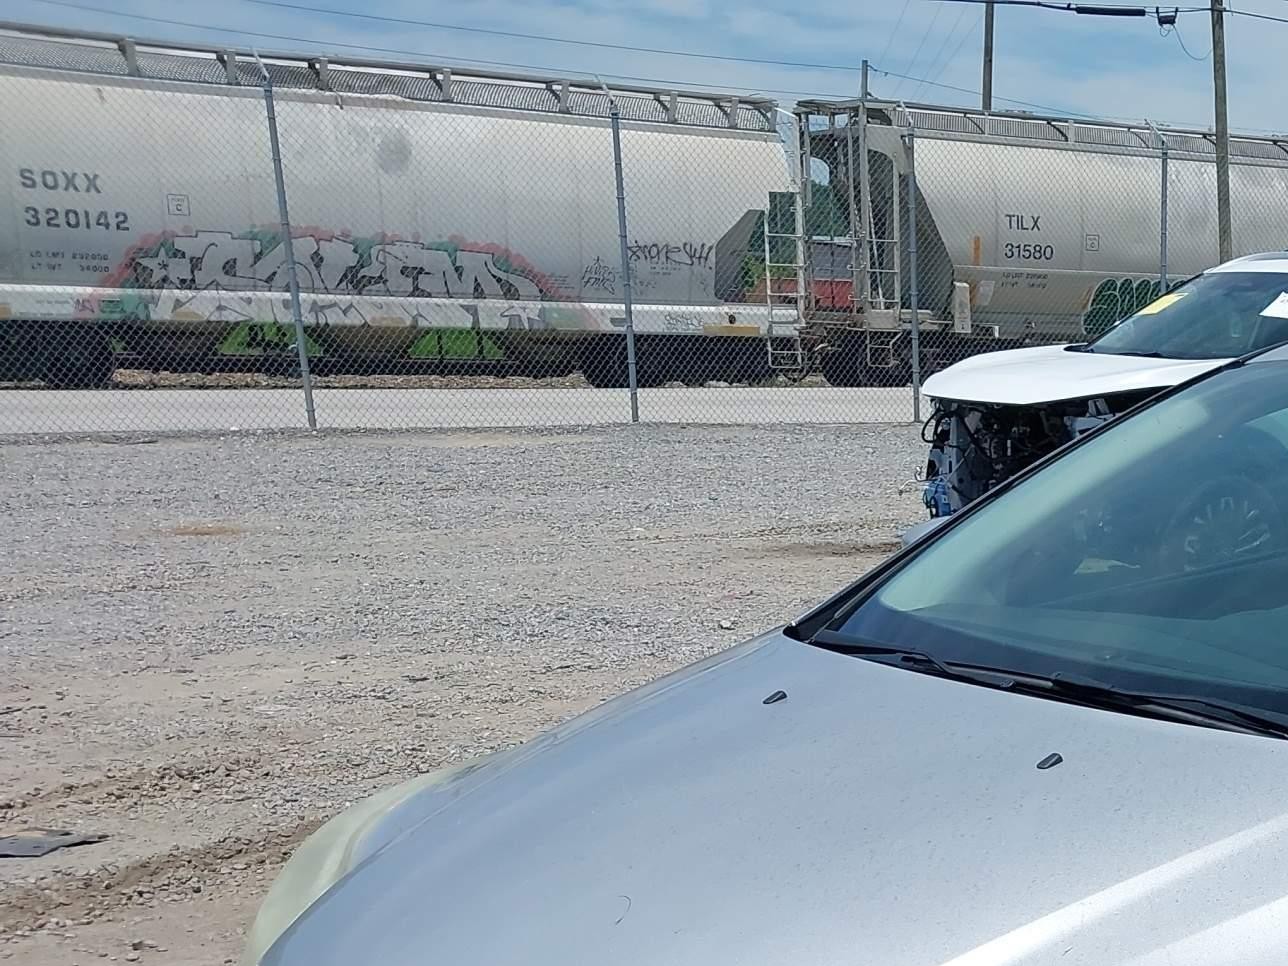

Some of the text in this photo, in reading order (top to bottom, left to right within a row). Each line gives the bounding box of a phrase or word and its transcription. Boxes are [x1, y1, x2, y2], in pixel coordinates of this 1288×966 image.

[20, 168, 101, 193] SOXX
[24, 206, 129, 231] 320142
[1005, 214, 1041, 231] TILX
[1004, 242, 1054, 260] 31580
